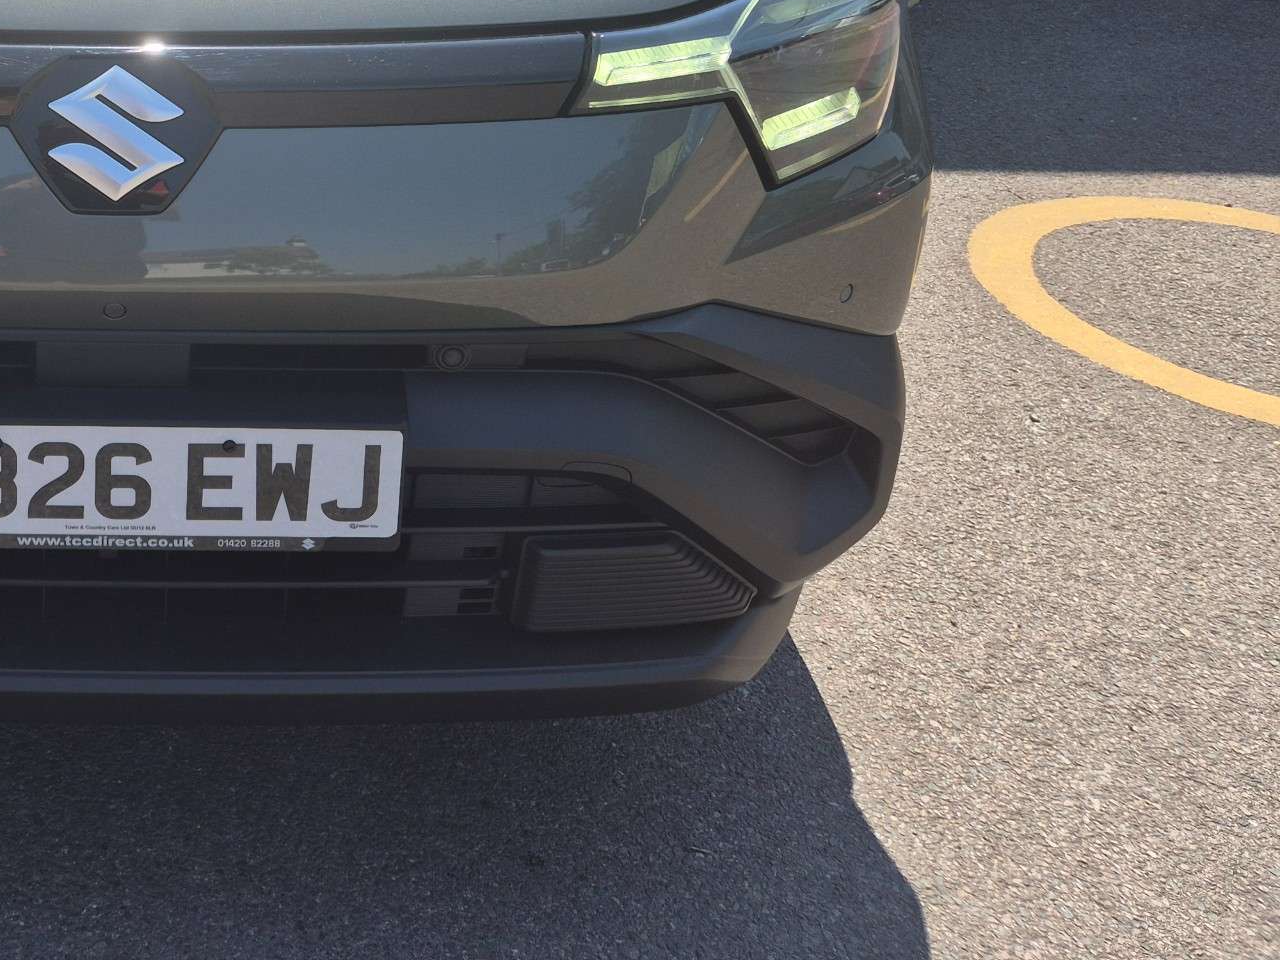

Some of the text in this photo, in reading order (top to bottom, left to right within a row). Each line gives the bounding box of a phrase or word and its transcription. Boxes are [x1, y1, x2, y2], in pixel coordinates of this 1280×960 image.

[185, 442, 382, 522] EWJ
[17, 536, 195, 548] www.tccdirect.co.uk
[217, 538, 246, 548] 01420
